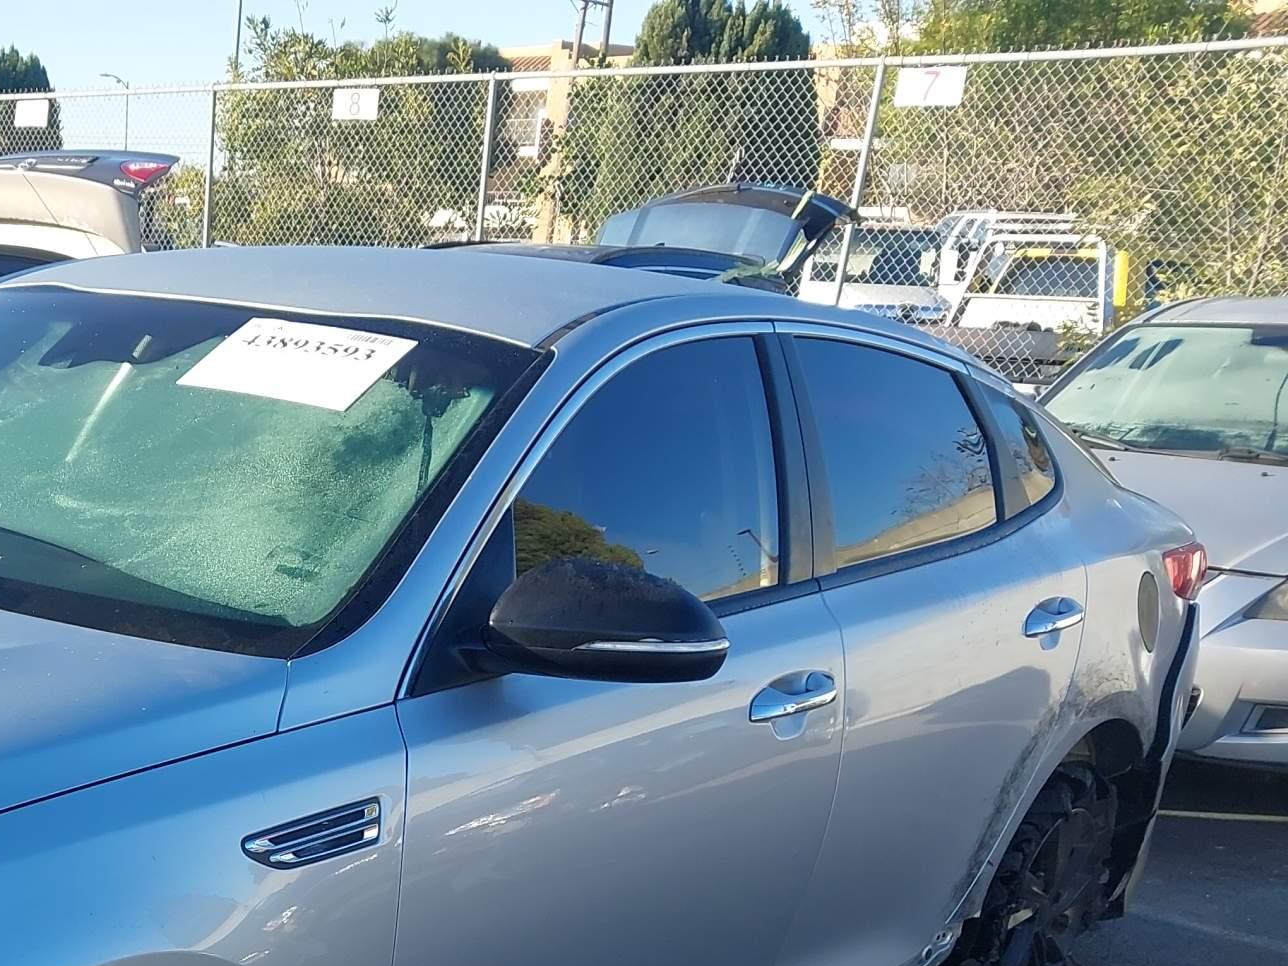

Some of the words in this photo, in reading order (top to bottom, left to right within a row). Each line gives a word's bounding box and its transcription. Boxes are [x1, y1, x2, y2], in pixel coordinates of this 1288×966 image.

[923, 70, 941, 101] 7
[349, 92, 361, 116] 8
[241, 333, 377, 361] 43893593
